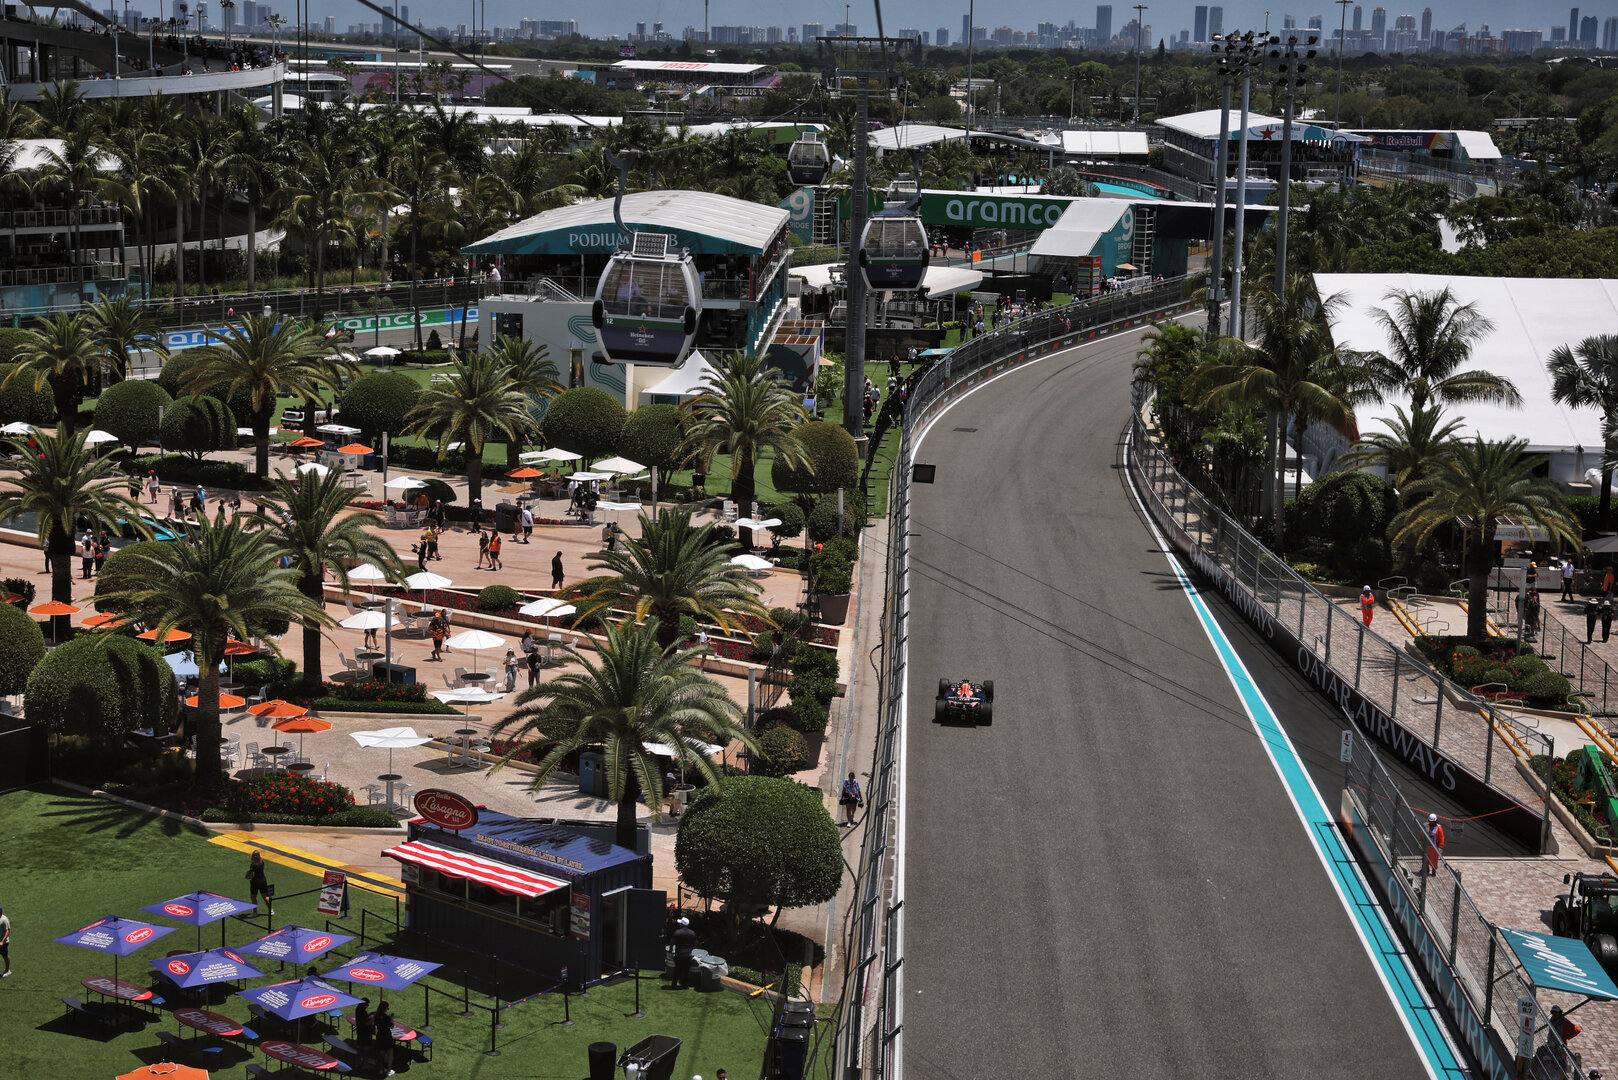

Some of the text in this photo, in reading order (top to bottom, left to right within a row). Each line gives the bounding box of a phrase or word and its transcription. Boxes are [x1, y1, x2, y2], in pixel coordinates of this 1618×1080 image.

[733, 88, 757, 96] LOUIS
[1406, 136, 1423, 145] Bull
[790, 190, 810, 221] 9
[946, 199, 1063, 225] aramco
[1121, 207, 1134, 241] 9
[569, 233, 630, 247] PODIUM
[1224, 576, 1274, 639] AIRWAYS
[1297, 646, 1457, 791] QATAR AIRWAYS
[420, 796, 468, 819] Lasagna
[87, 978, 141, 998] Barilla
[1387, 876, 1509, 1080] QATAR AIRW
[178, 1011, 233, 1033] Barilla
[267, 1043, 327, 1066] Barilla
